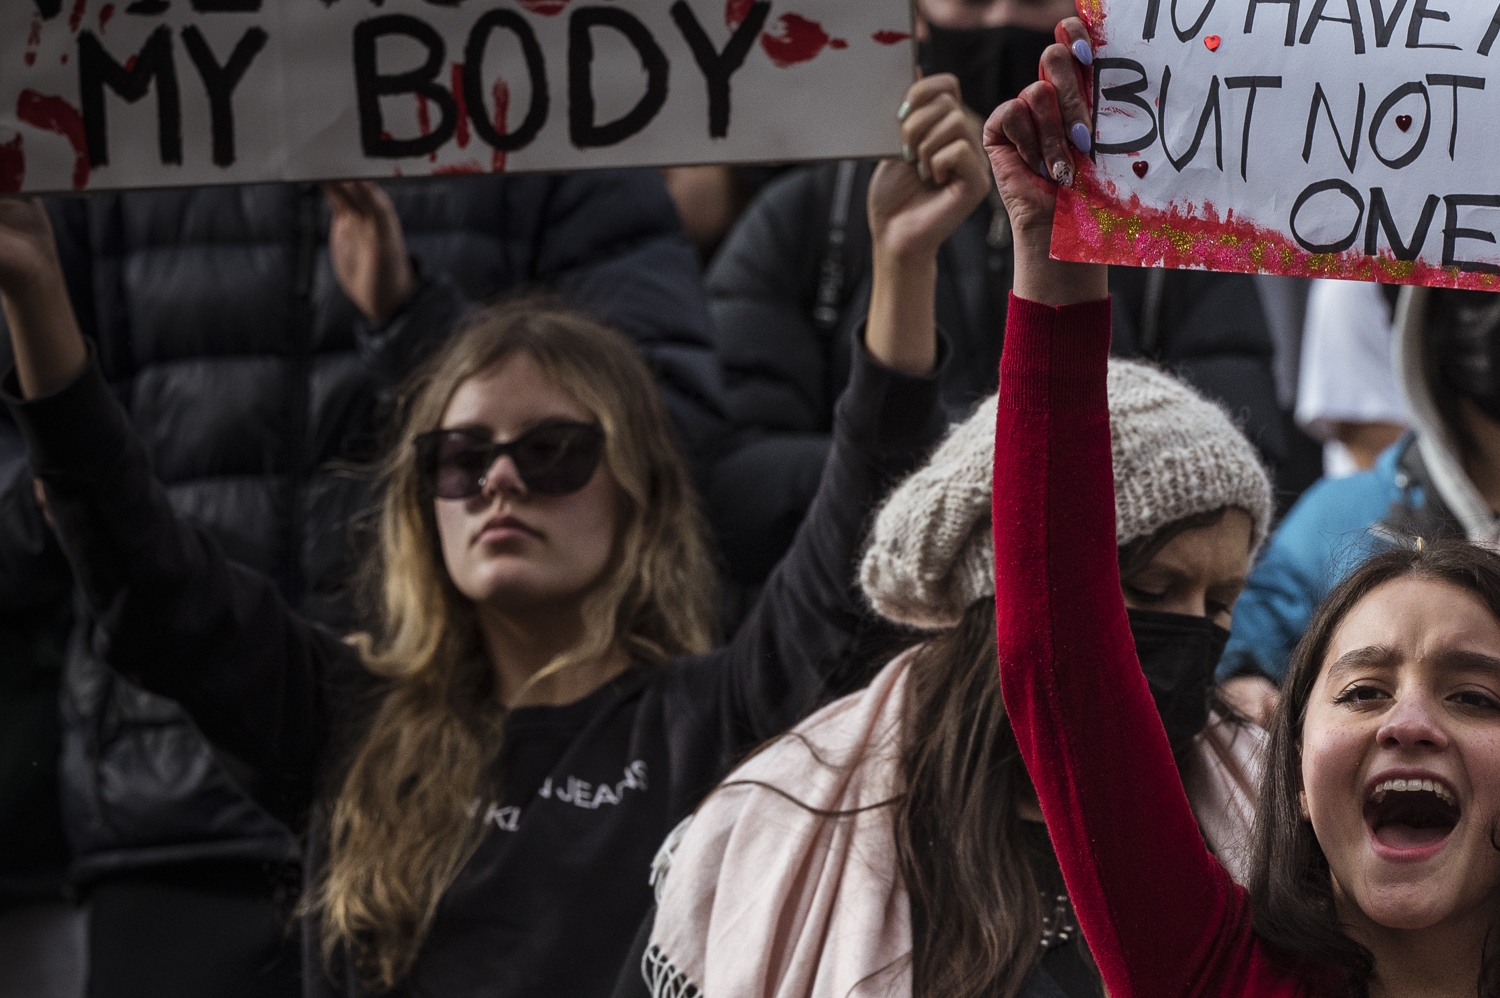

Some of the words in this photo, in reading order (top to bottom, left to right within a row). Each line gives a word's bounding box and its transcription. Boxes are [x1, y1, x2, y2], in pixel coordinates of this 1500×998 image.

[1243, 0, 1463, 54] HAVE
[78, 25, 268, 167] MY
[353, 0, 771, 158] BODY
[1090, 57, 1283, 183] BUT
[1301, 73, 1486, 174] NOT
[555, 759, 649, 810] JEANS
